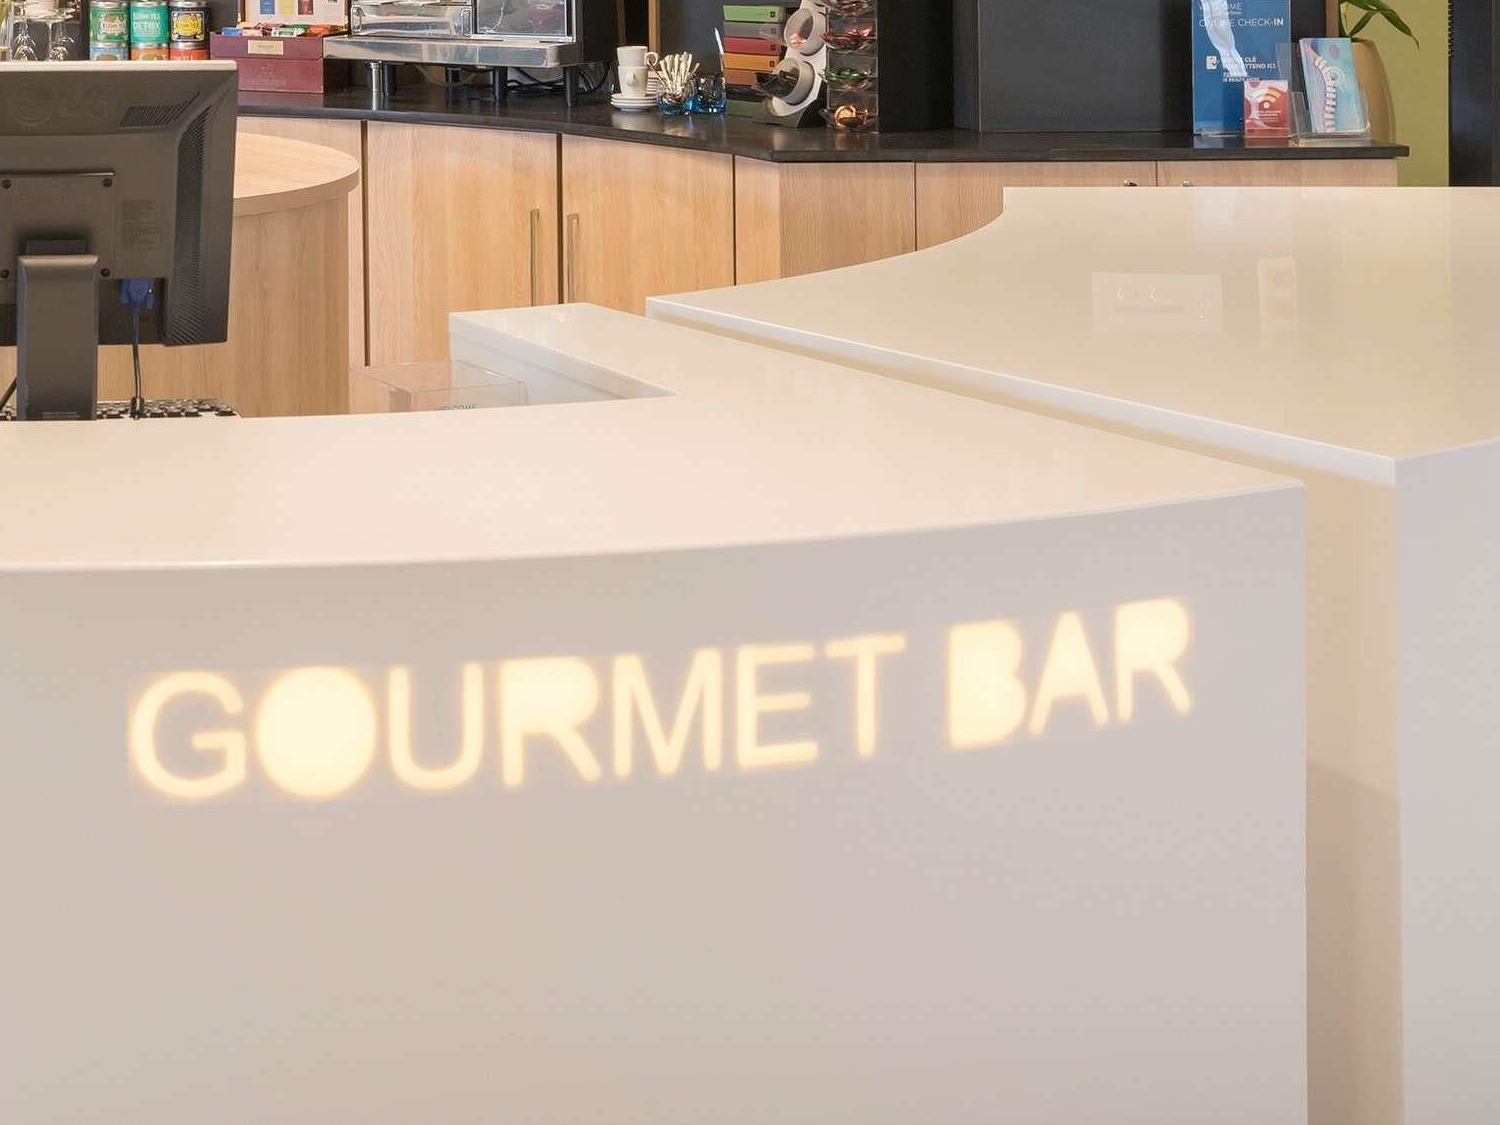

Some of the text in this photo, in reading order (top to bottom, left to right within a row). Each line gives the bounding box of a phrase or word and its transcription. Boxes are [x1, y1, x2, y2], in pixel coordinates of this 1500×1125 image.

[1237, 18, 1284, 27] CHECK-IN
[126, 597, 1193, 800] GOURMET BAR
